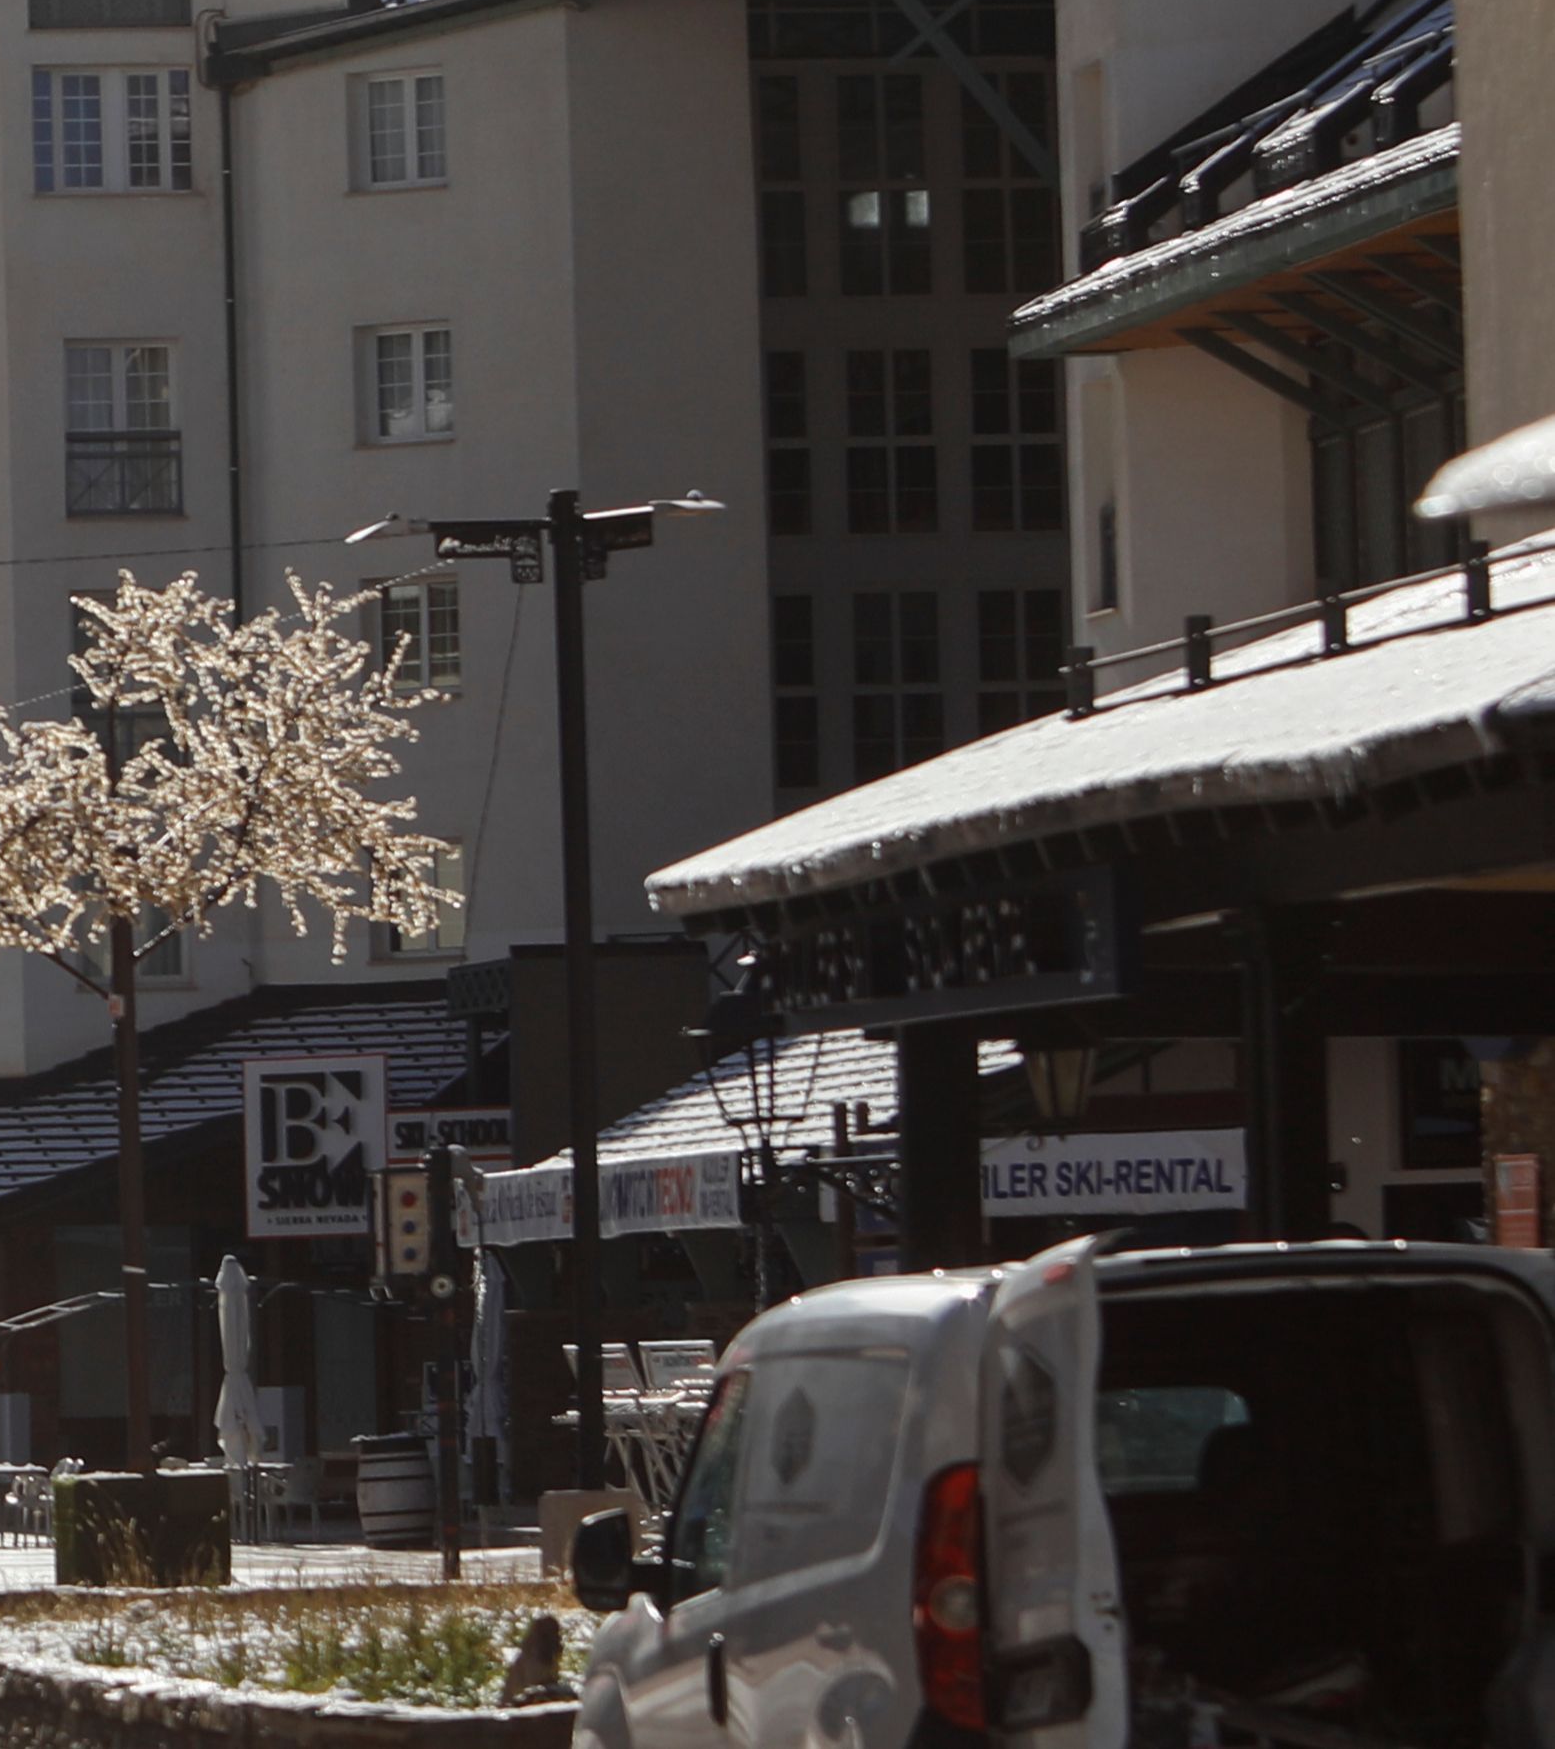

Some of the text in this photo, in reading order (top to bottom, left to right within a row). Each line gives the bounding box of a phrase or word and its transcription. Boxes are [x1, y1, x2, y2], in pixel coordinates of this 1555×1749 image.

[257, 1166, 368, 1209] SNOW
[981, 1158, 1234, 1199] ILER SKI-RENTAL
